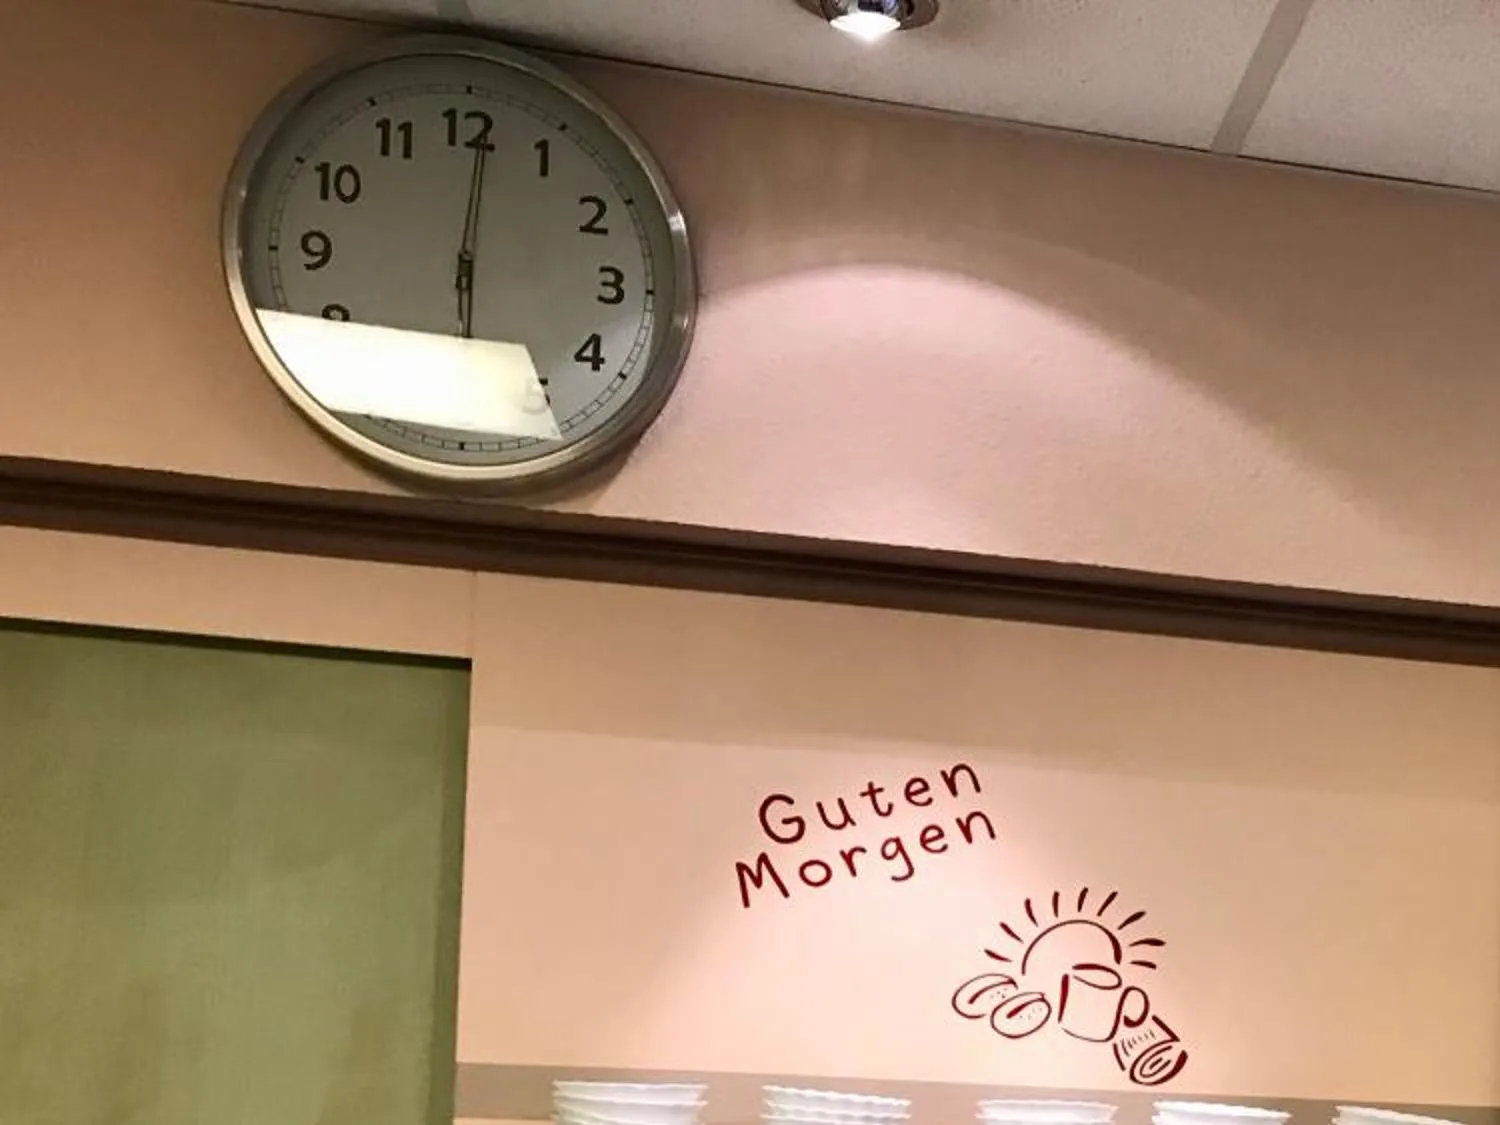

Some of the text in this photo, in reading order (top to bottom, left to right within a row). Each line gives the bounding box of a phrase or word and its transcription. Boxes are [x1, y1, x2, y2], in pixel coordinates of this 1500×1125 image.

[375, 117, 413, 159] 11
[442, 108, 495, 151] 12
[533, 139, 550, 177] 1
[314, 162, 362, 204] 10
[578, 195, 609, 235] 2
[300, 230, 333, 270] 9
[597, 266, 625, 304] 3
[574, 333, 605, 371] 4
[758, 763, 982, 844] Guten
[735, 810, 997, 908] Morgen
